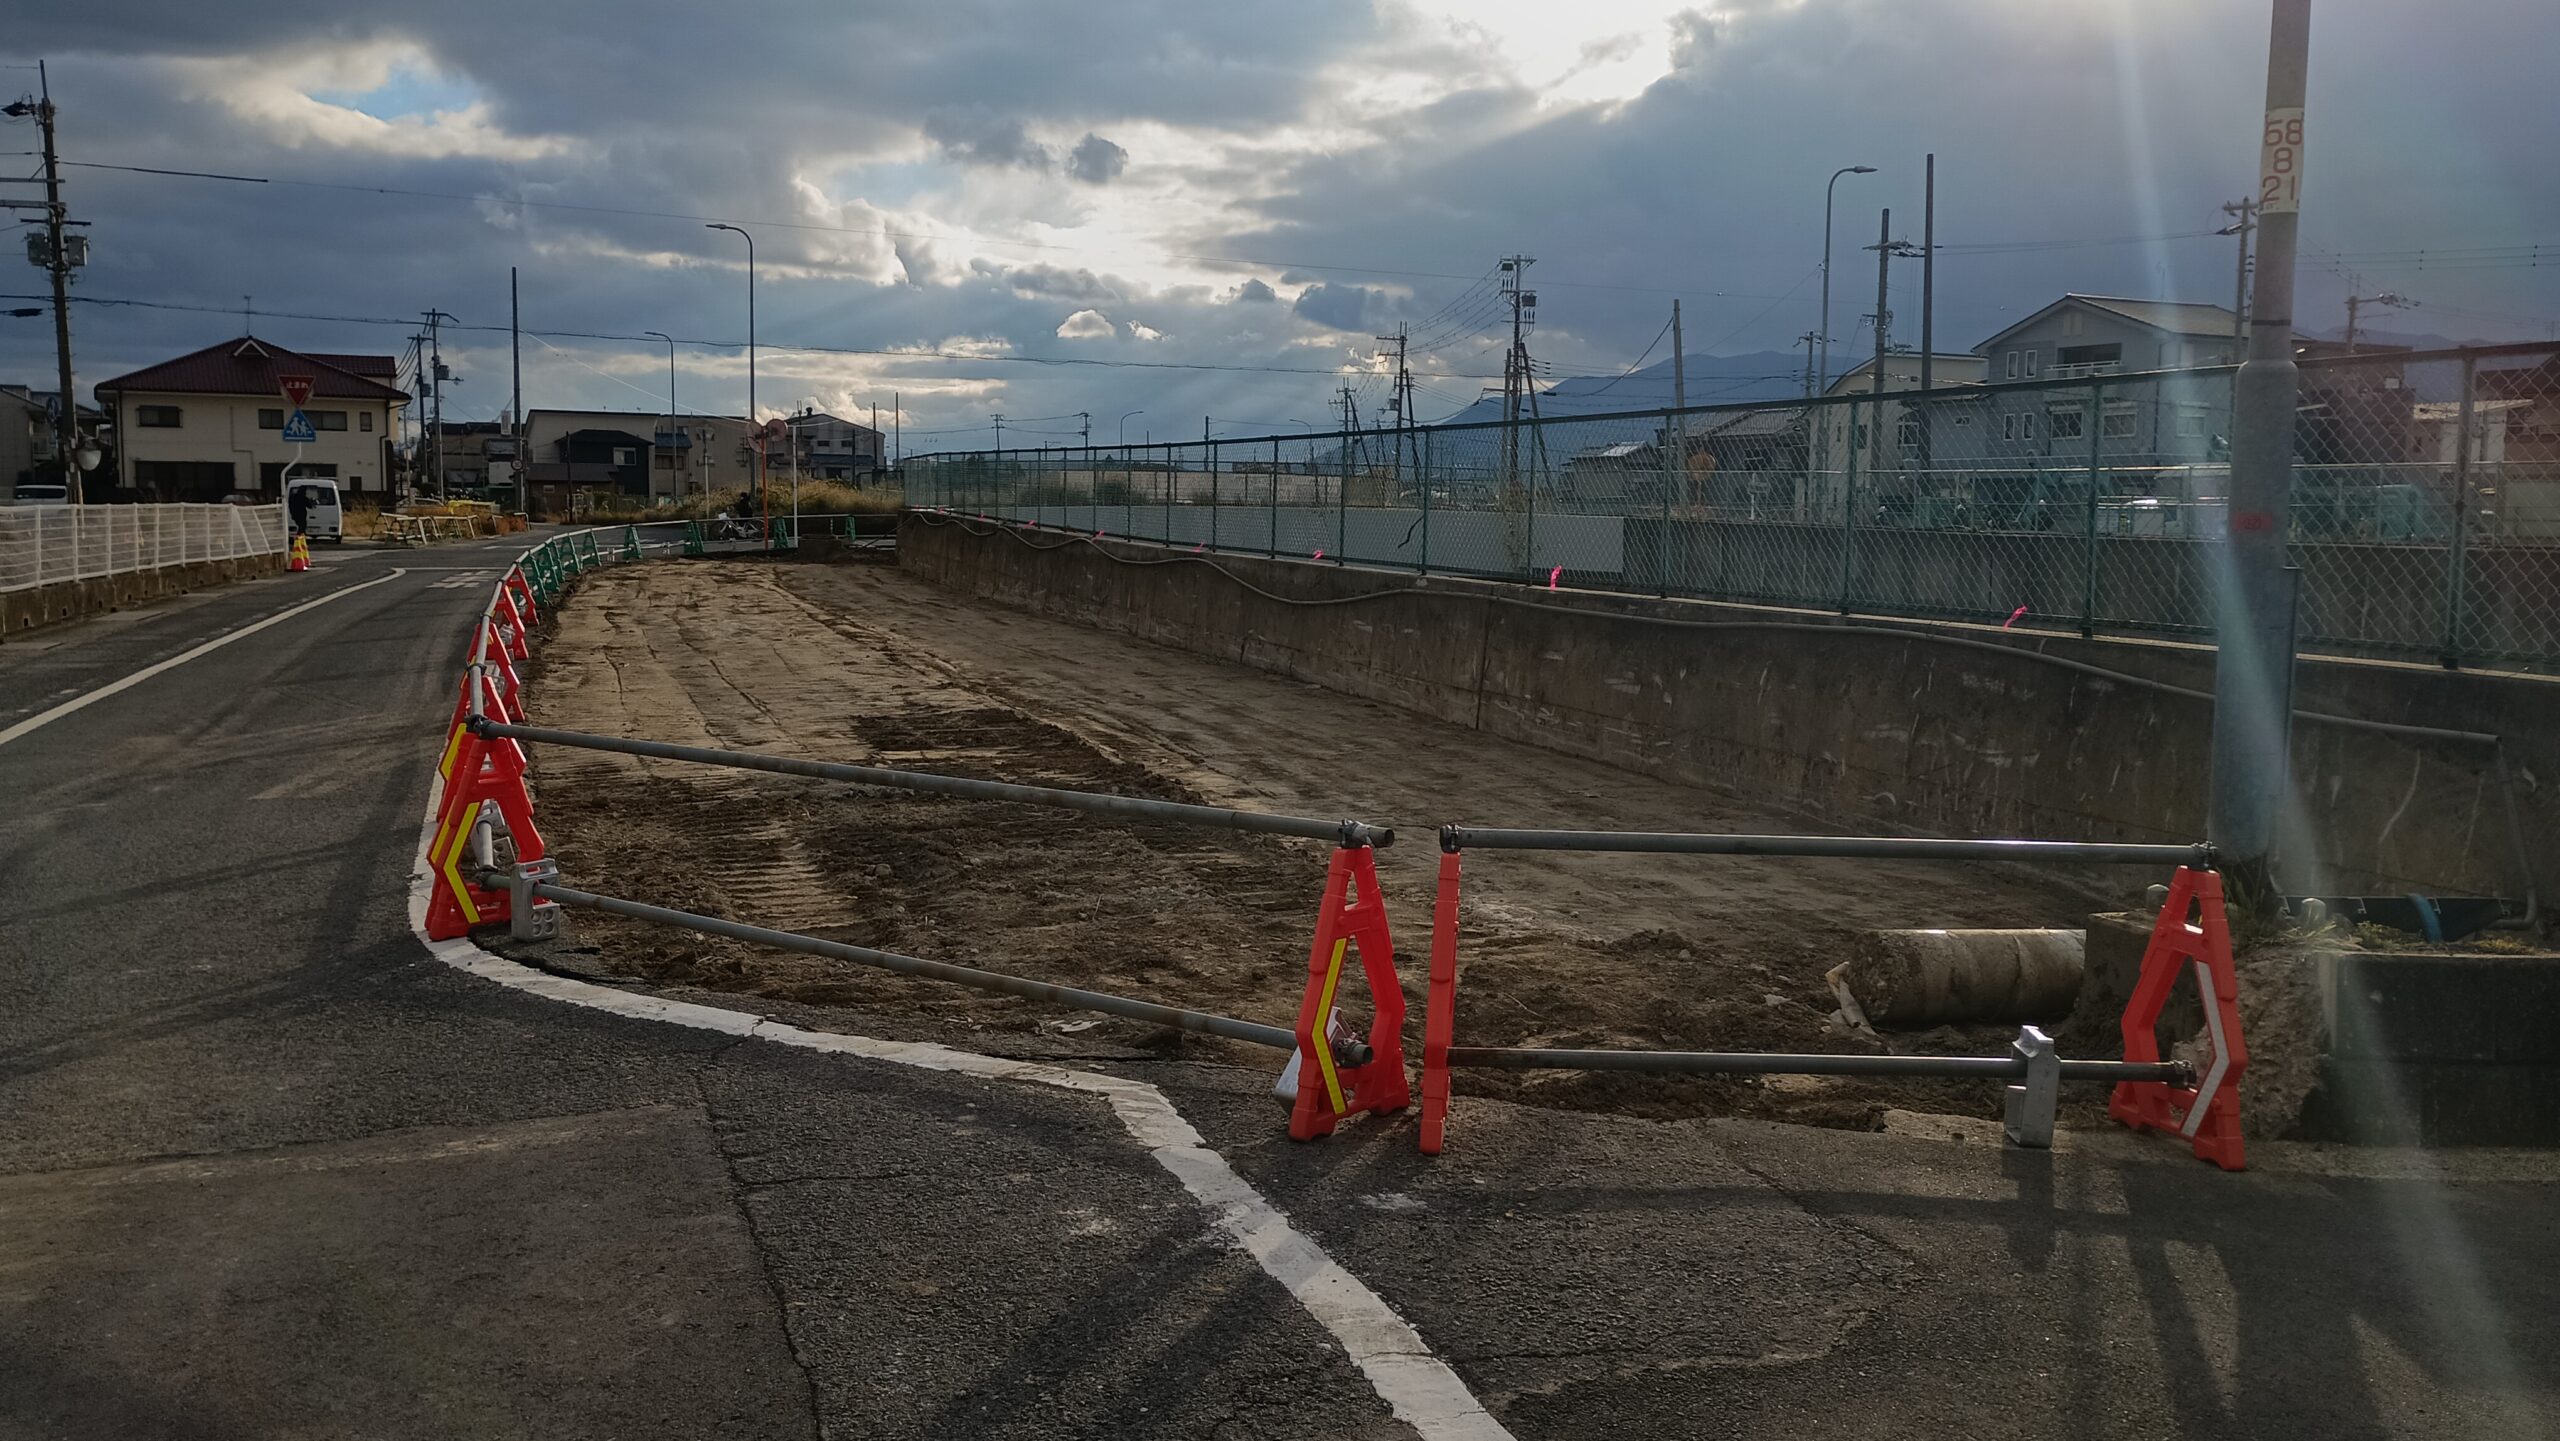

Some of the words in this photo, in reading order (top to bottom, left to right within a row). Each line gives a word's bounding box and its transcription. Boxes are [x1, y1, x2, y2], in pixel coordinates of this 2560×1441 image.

[2265, 118, 2303, 146] 58
[2273, 147, 2293, 174] 8
[2262, 175, 2296, 202] 21
